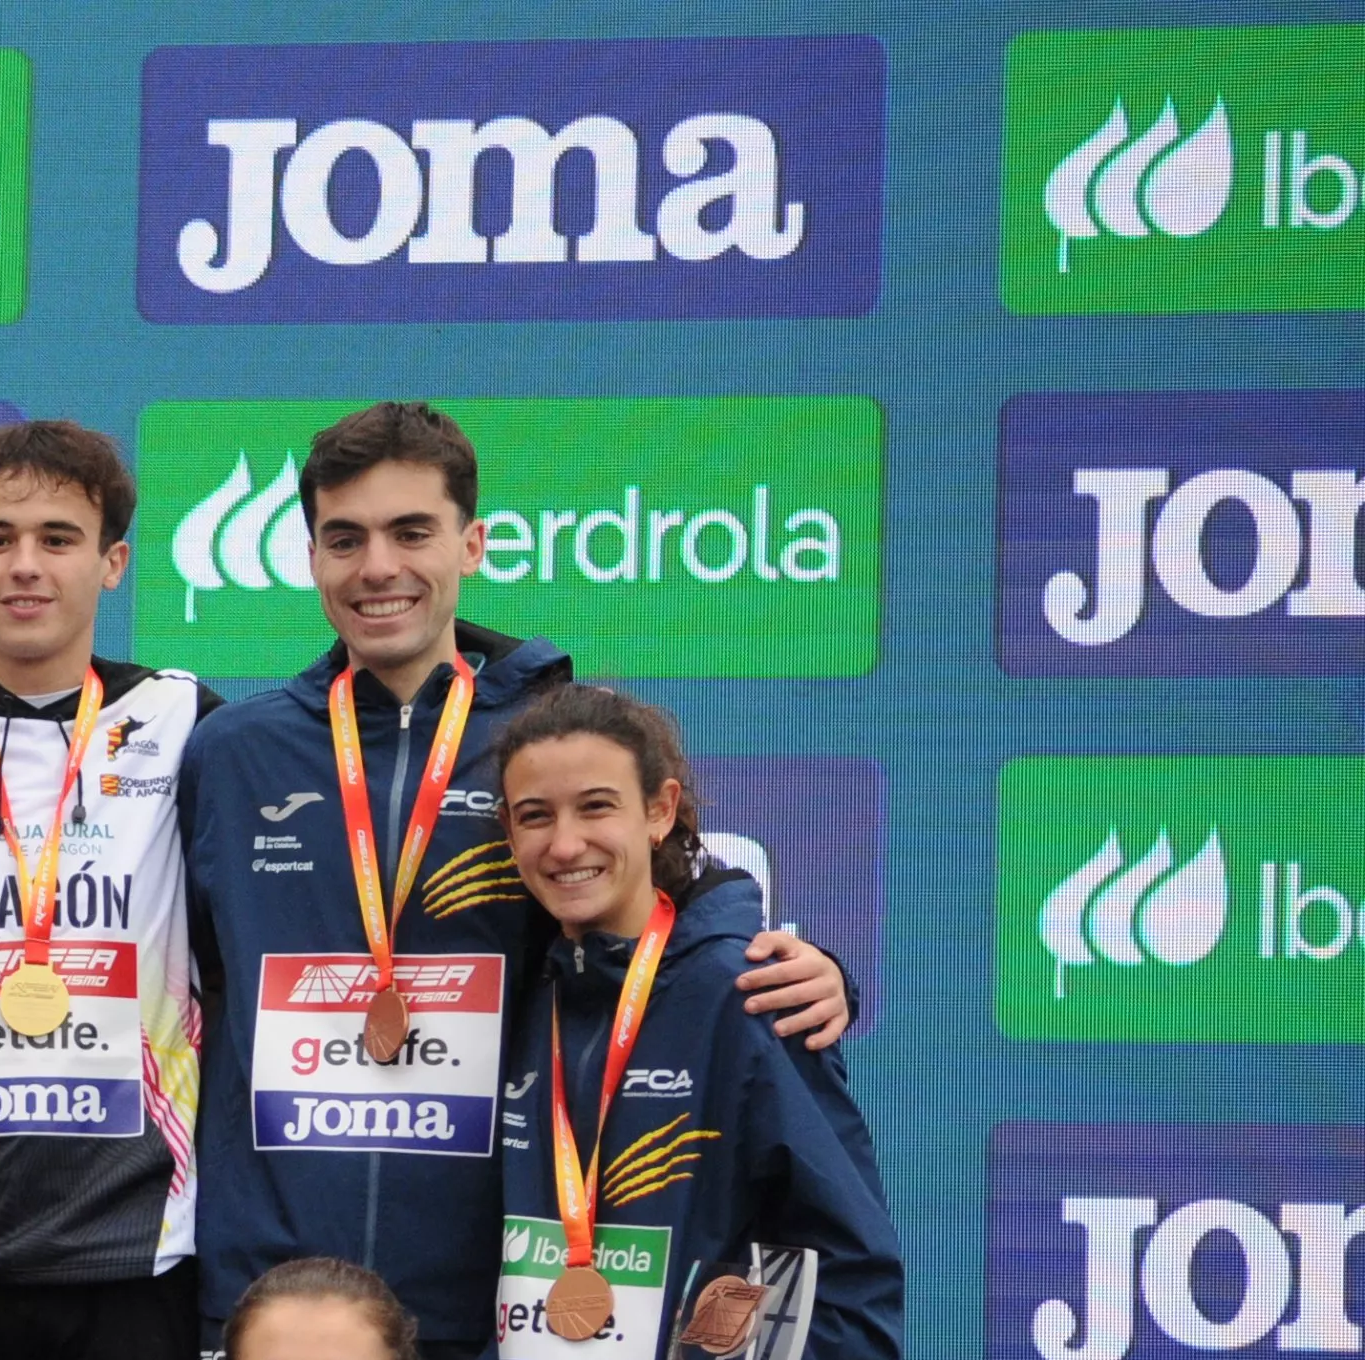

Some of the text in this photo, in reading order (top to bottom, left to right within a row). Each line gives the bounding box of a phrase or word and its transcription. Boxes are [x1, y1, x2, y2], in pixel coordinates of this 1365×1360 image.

[177, 112, 804, 293] Joma
[118, 788, 131, 797] DE
[119, 776, 173, 788] GOBIERNO
[438, 790, 503, 811] FC
[265, 861, 314, 874] esportcat
[623, 1069, 693, 1090] FCA
[284, 1098, 455, 1142] Joma
